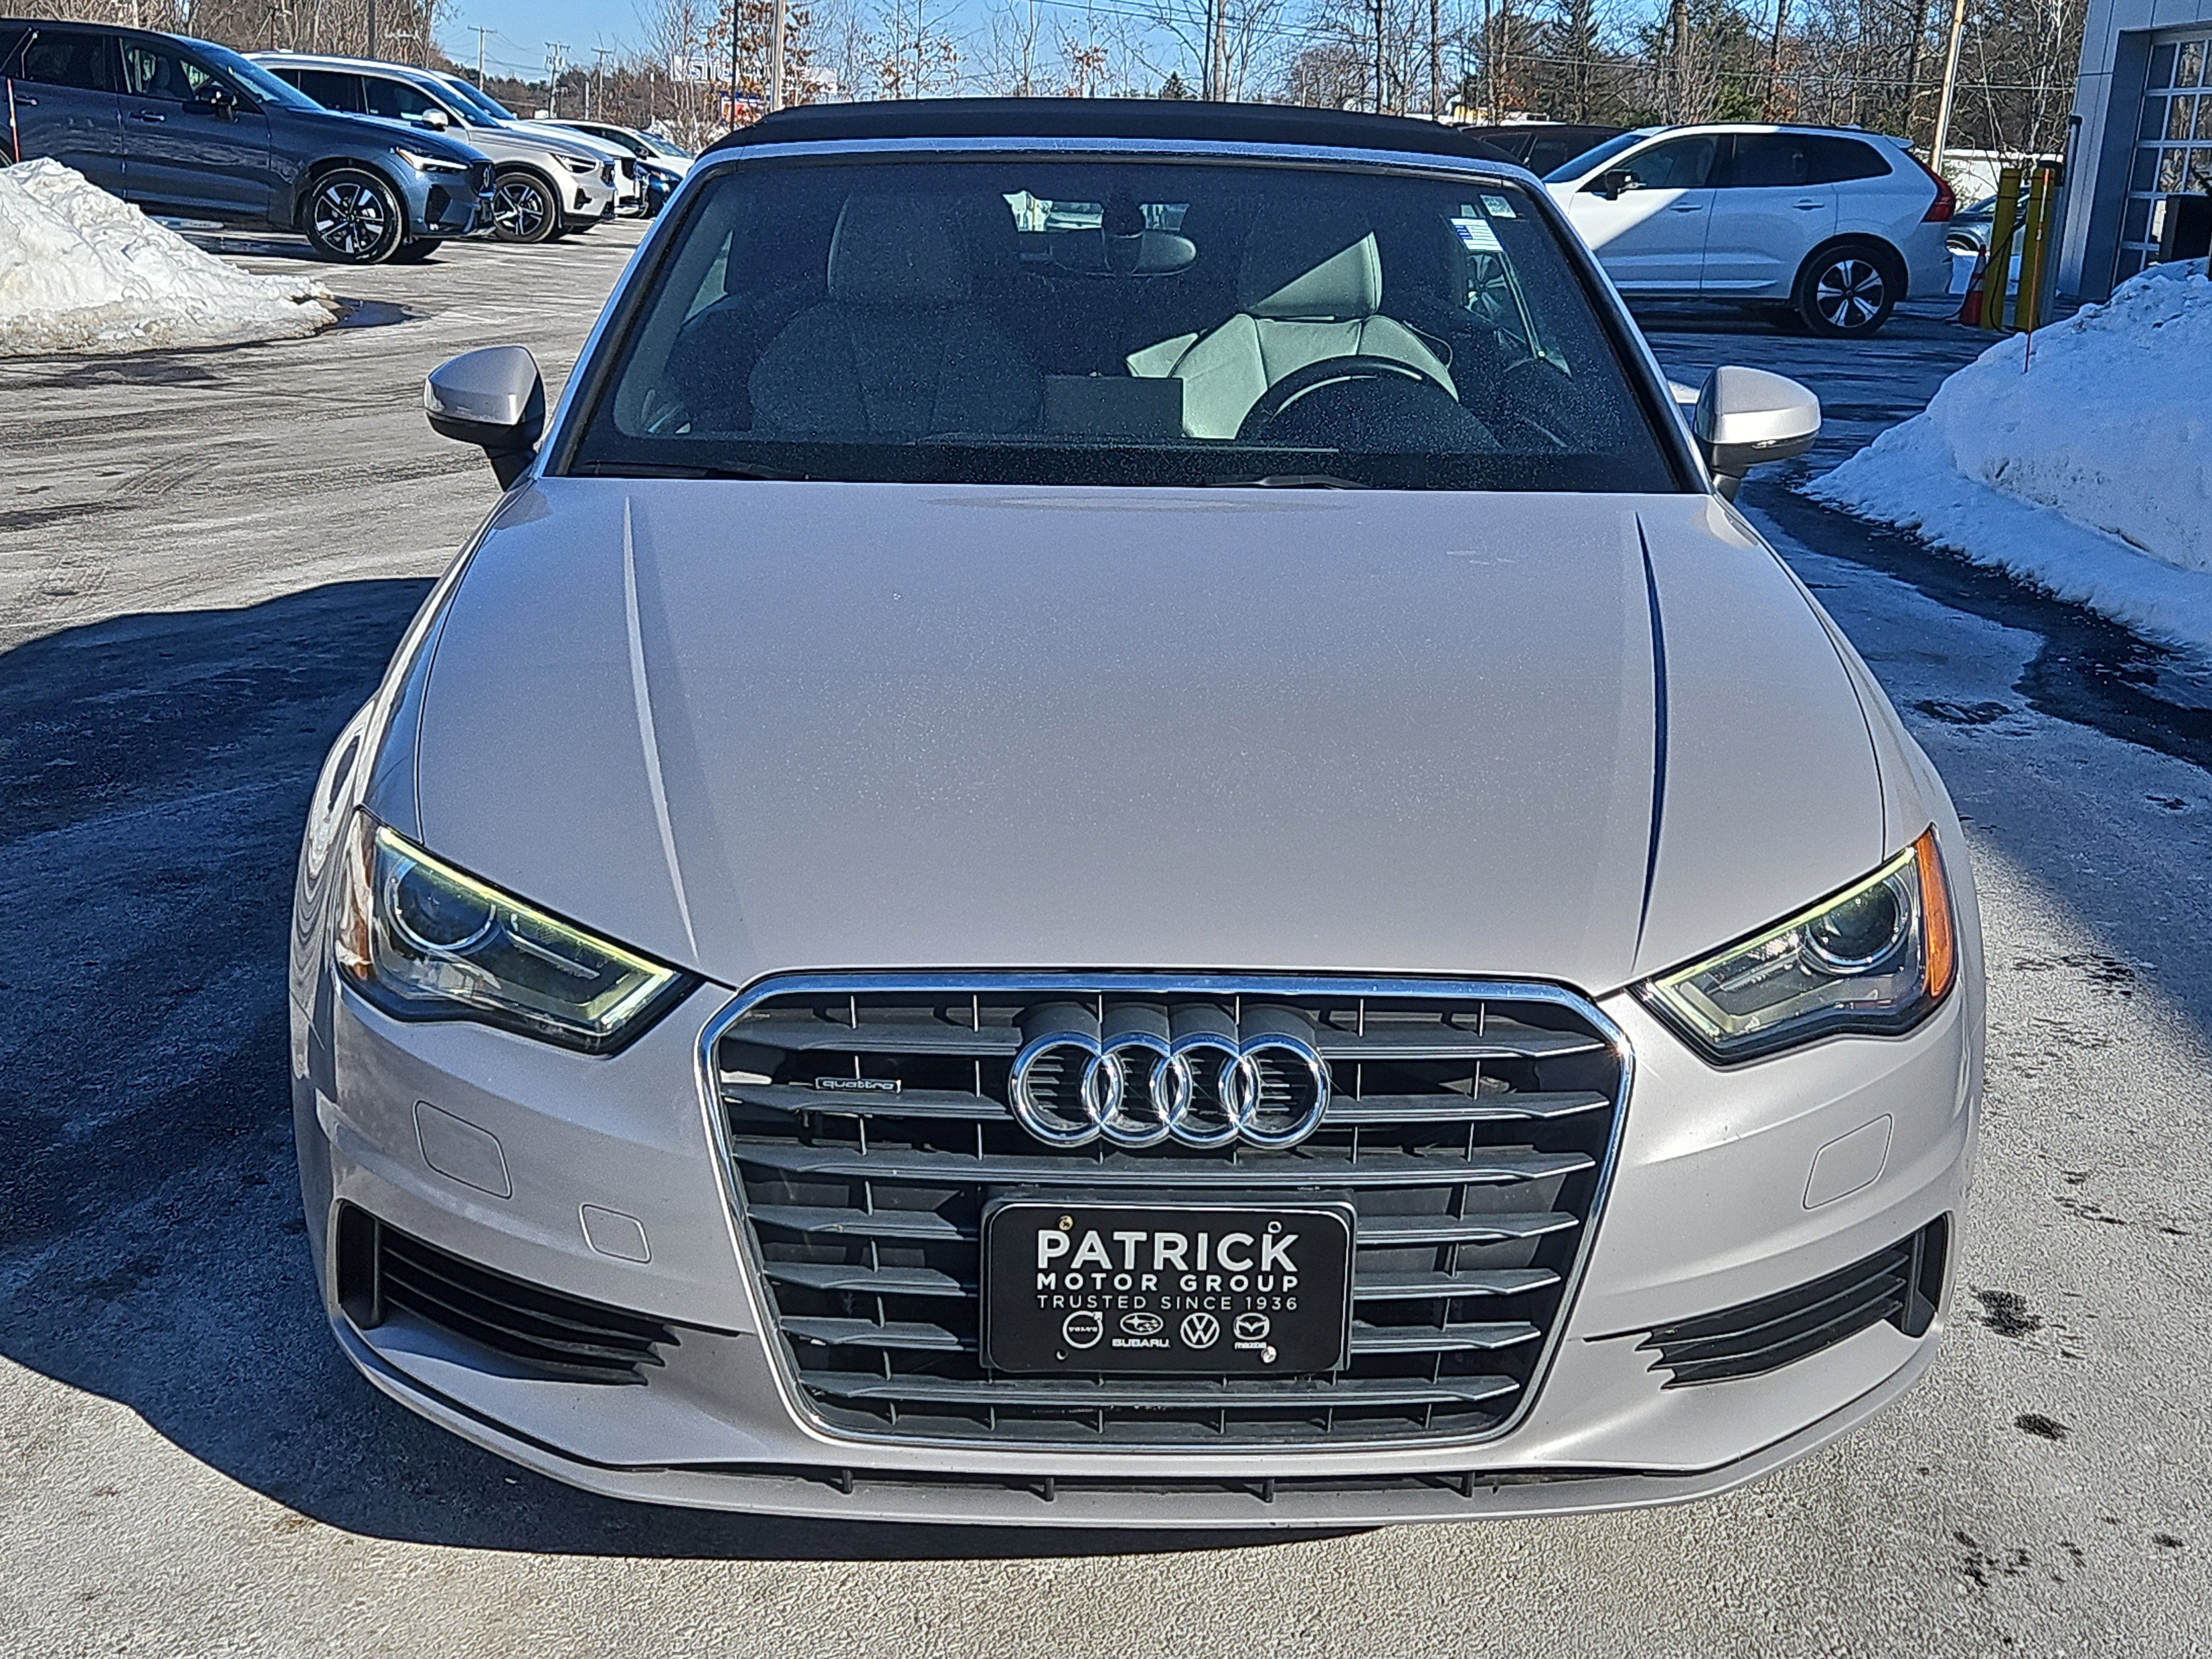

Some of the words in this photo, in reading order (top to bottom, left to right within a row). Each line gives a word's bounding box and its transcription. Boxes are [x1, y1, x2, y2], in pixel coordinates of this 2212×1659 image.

[822, 1078, 894, 1090] quattro
[1037, 1229, 1299, 1272] PATRICK
[1037, 1273, 1158, 1291] MOTOR
[1179, 1274, 1298, 1293] GROUP
[1037, 1295, 1147, 1309] TRUSTED
[1161, 1296, 1232, 1310] SINCE
[1246, 1296, 1297, 1311] 1936
[1112, 1339, 1171, 1348] SUBARU
